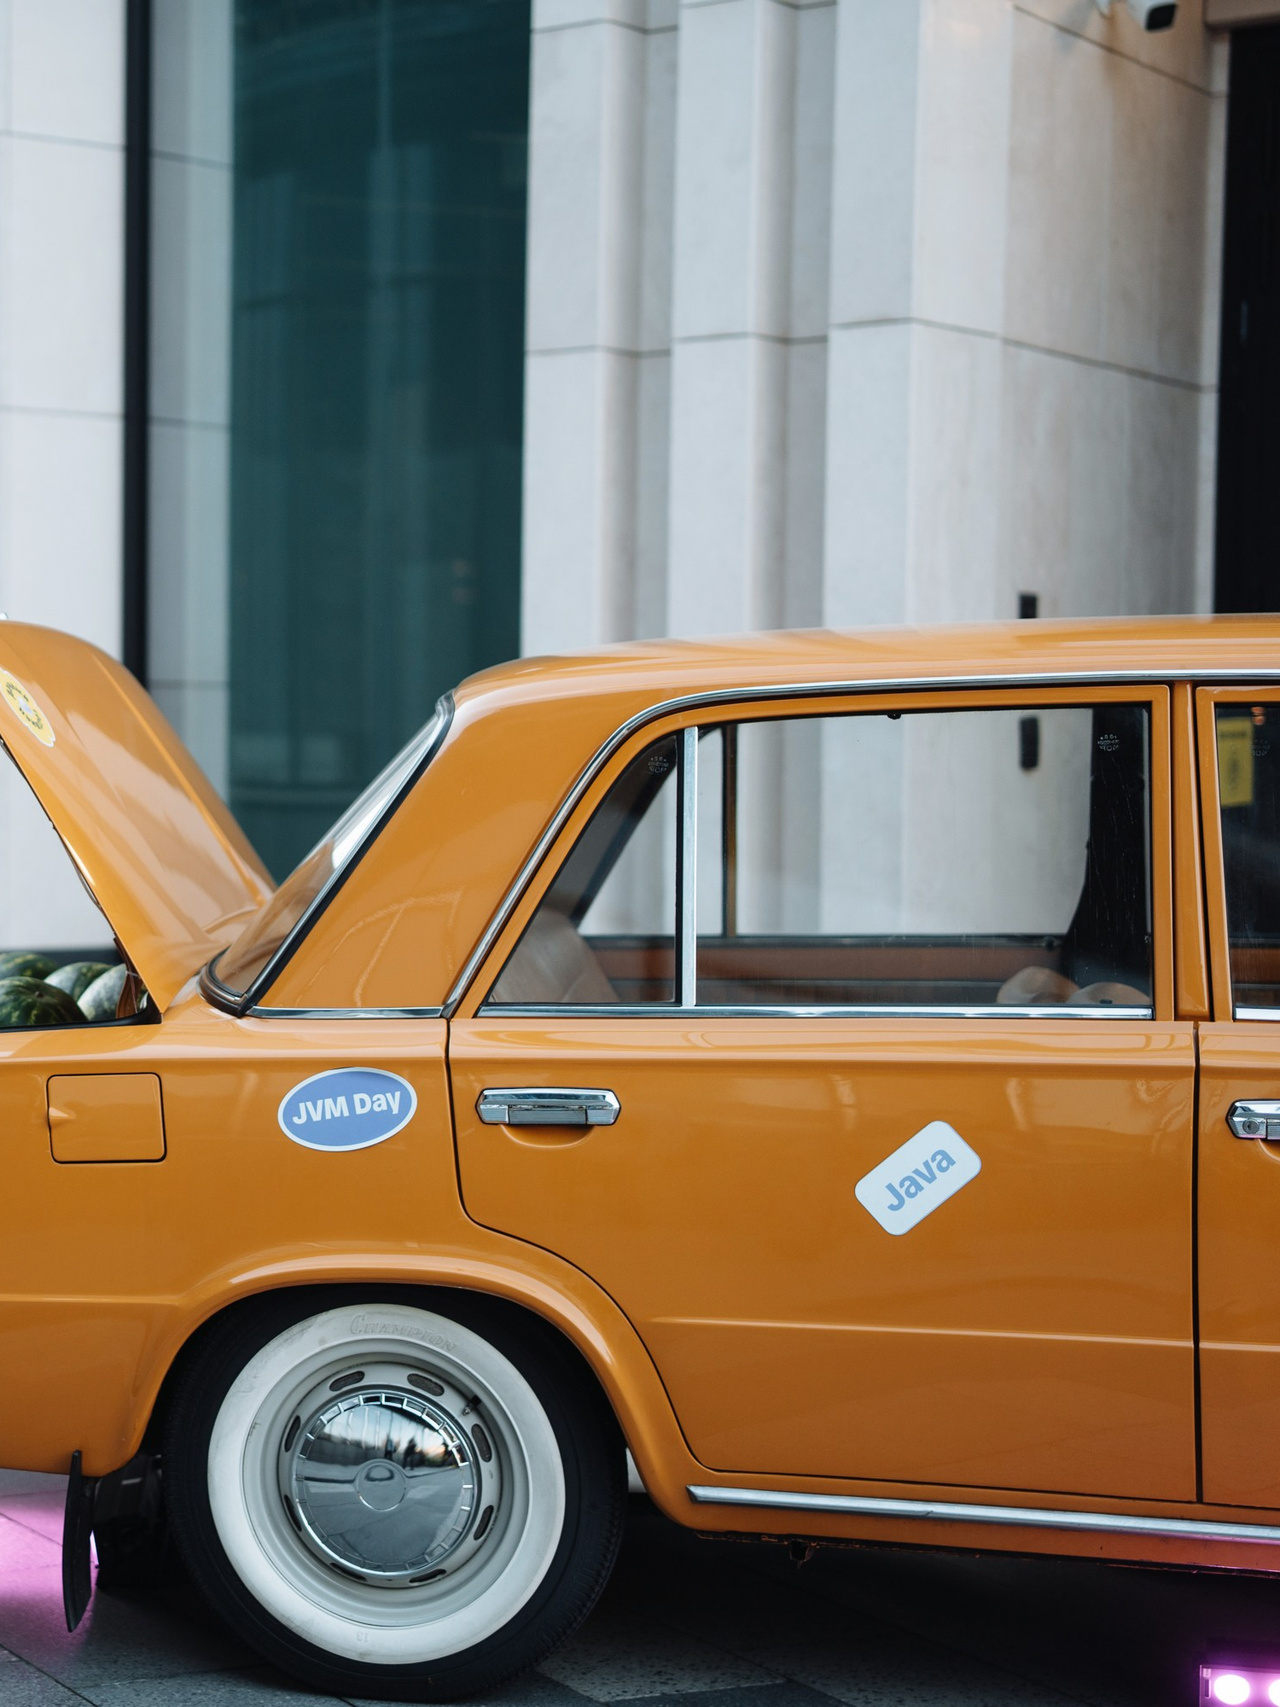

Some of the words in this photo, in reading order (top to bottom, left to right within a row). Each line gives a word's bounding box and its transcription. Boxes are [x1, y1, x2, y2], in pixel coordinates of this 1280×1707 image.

[292, 1095, 350, 1125] JVM
[353, 1090, 401, 1115] Day
[884, 1149, 957, 1212] Java
